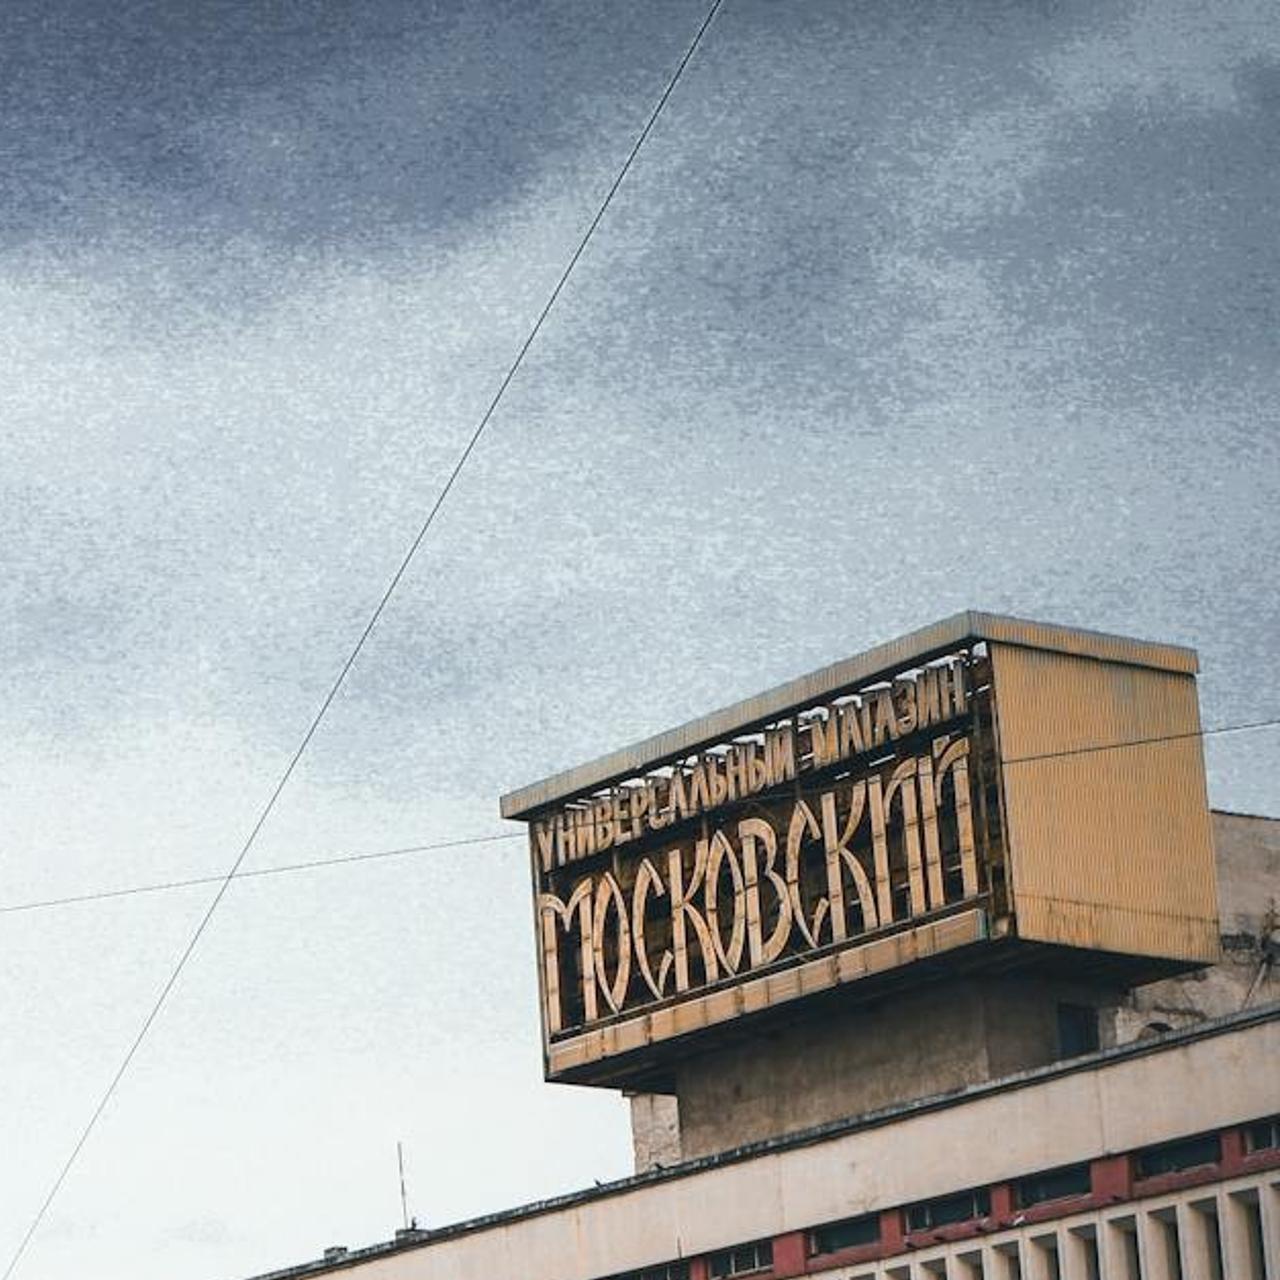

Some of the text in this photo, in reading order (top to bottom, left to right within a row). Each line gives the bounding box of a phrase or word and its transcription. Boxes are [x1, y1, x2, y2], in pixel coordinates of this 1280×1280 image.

[538, 660, 968, 872] УНИВЕРСАЛЬНЫЙ МАГАЗИН
[539, 736, 979, 1034] МОСКОВСКИЙ
